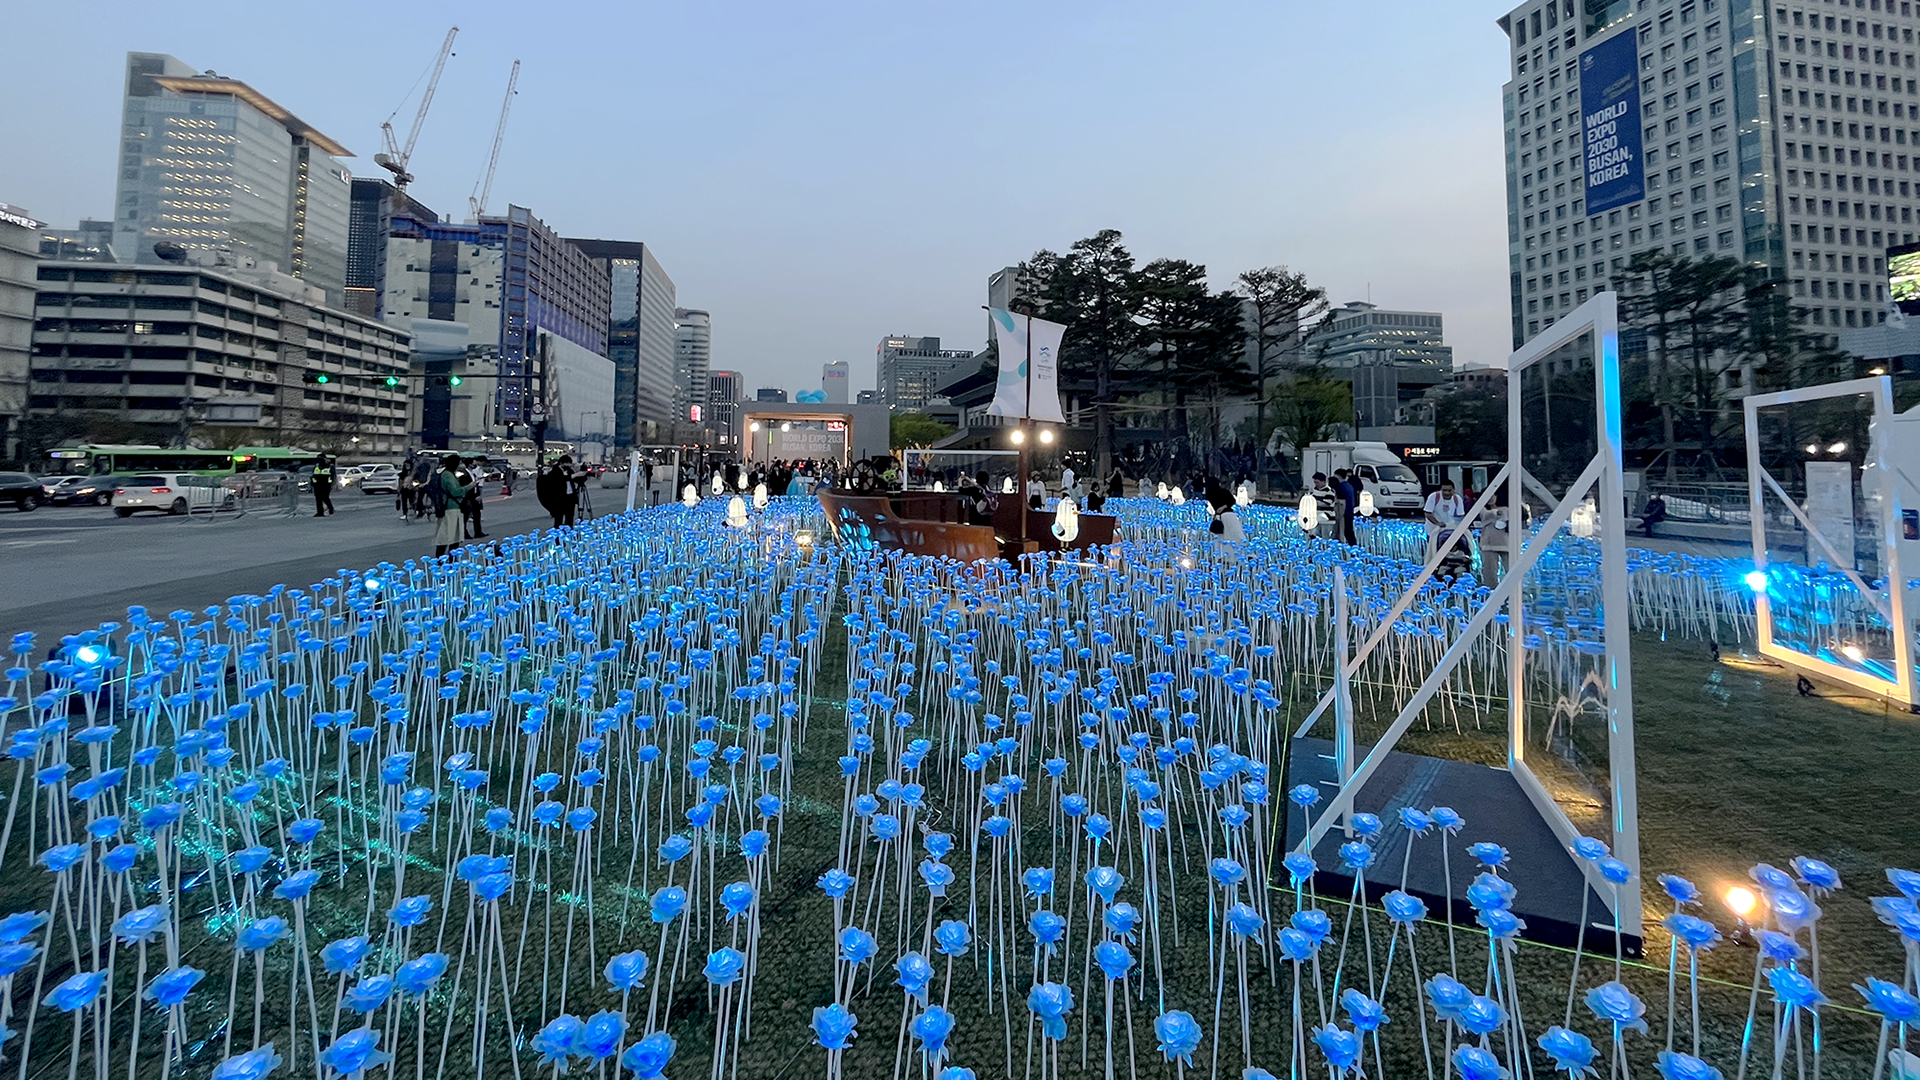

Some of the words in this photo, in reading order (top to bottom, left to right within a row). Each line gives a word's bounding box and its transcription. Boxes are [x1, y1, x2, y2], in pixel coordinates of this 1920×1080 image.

[1586, 100, 1628, 129] WORLD
[1587, 120, 1617, 143] EXPO
[1588, 135, 1618, 158] 2030
[1588, 146, 1633, 173] BUSAN,
[1589, 162, 1629, 188] KOREA
[781, 433, 808, 442] WORLD
[808, 434, 827, 443] EXPO
[781, 442, 807, 452] BUSAN,
[808, 443, 832, 452] KOREA
